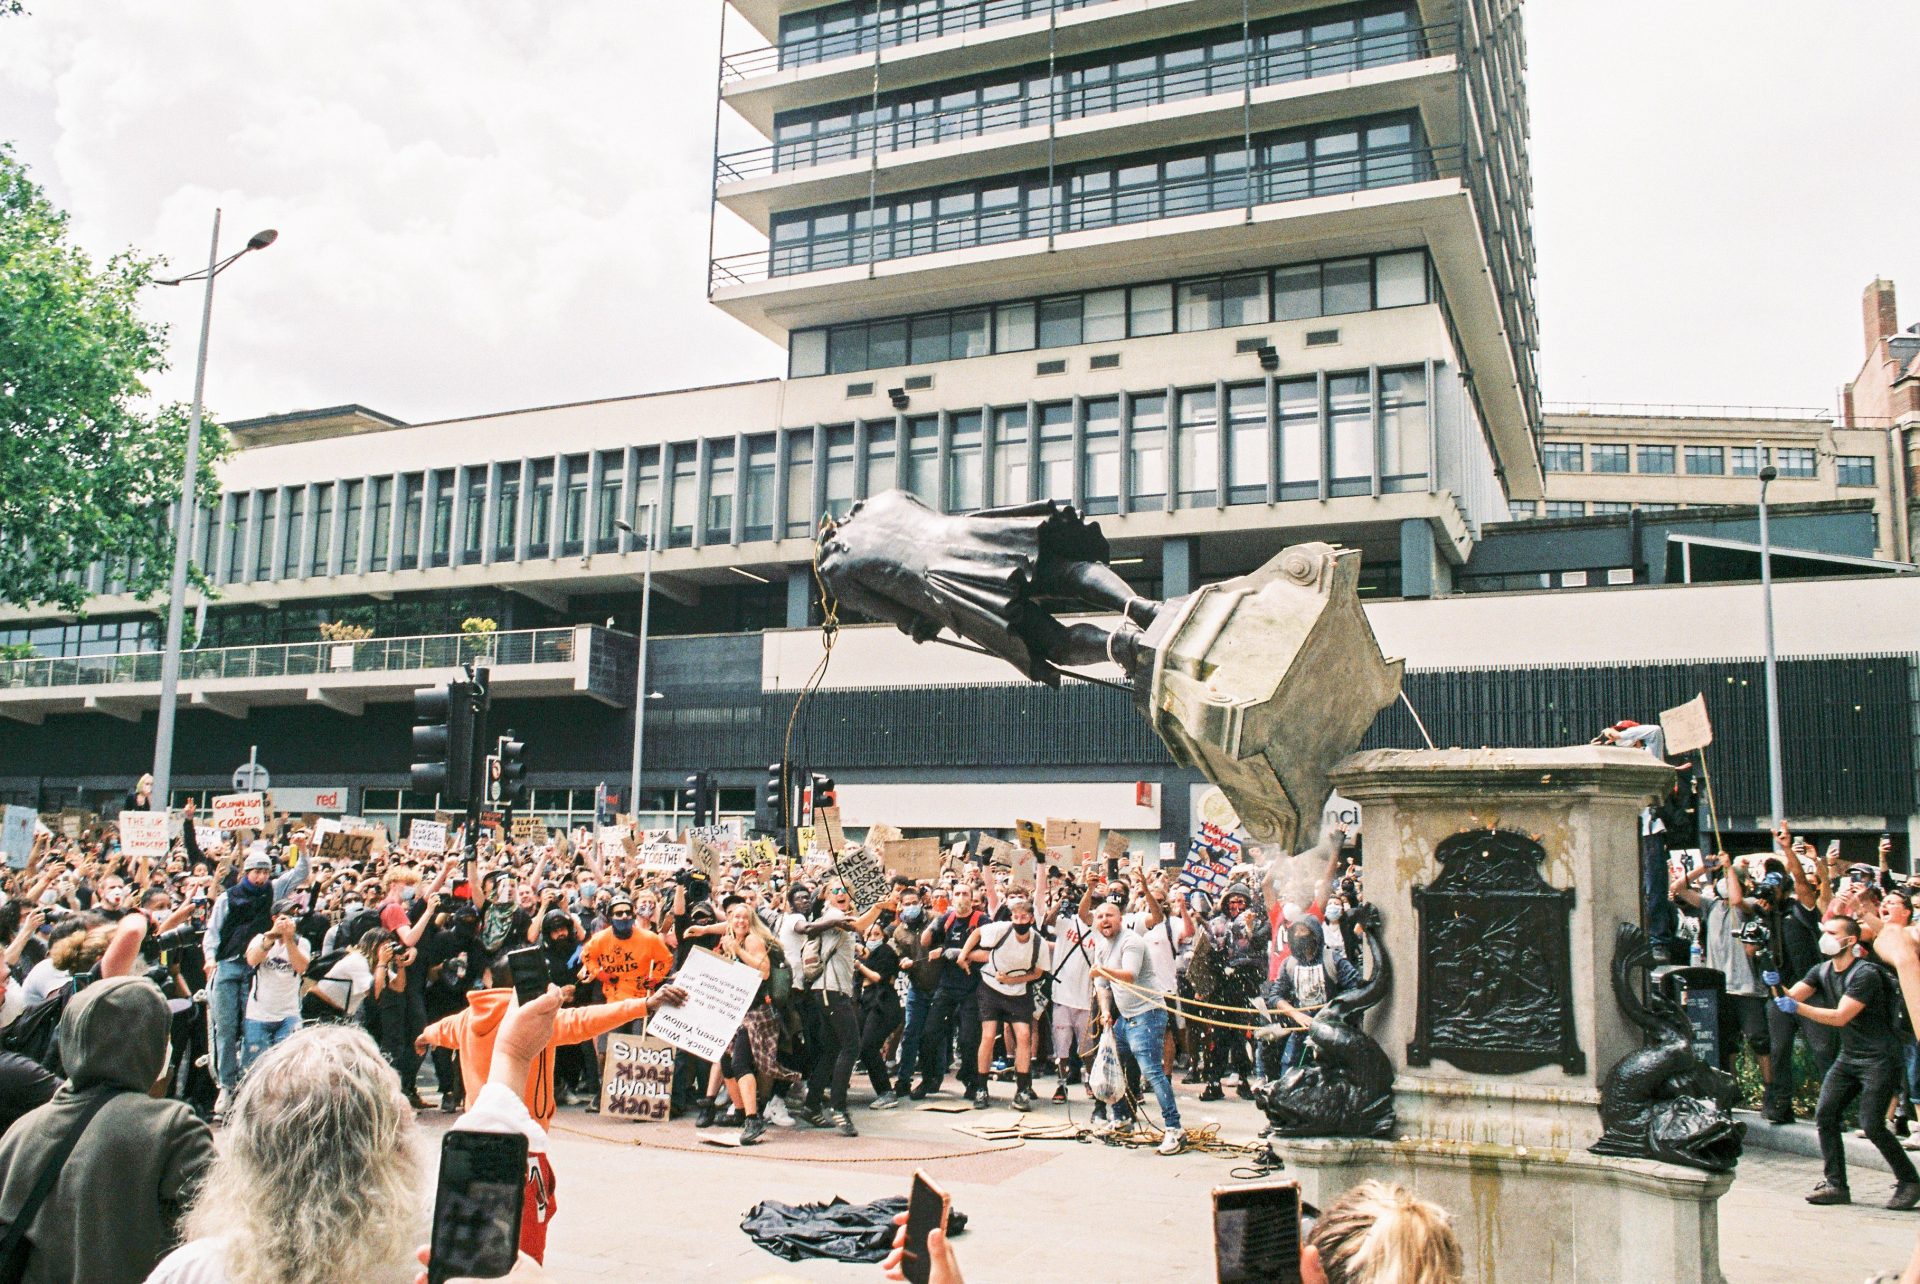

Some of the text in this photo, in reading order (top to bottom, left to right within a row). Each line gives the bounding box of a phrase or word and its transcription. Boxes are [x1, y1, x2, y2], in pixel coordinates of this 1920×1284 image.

[316, 792, 337, 806] red
[234, 809, 244, 817] IS
[218, 818, 260, 829] COOKED
[690, 824, 729, 838] RACISM
[1203, 822, 1228, 837] HOW
[321, 833, 374, 854] BLACK
[1204, 837, 1239, 853] WOULD
[853, 867, 882, 889] ESSOR
[1187, 863, 1209, 878] LIKE
[613, 1041, 675, 1067] BORIS
[616, 1062, 672, 1084] FUCK
[607, 1077, 671, 1099] TRUMP
[608, 1094, 668, 1118] FUCK
